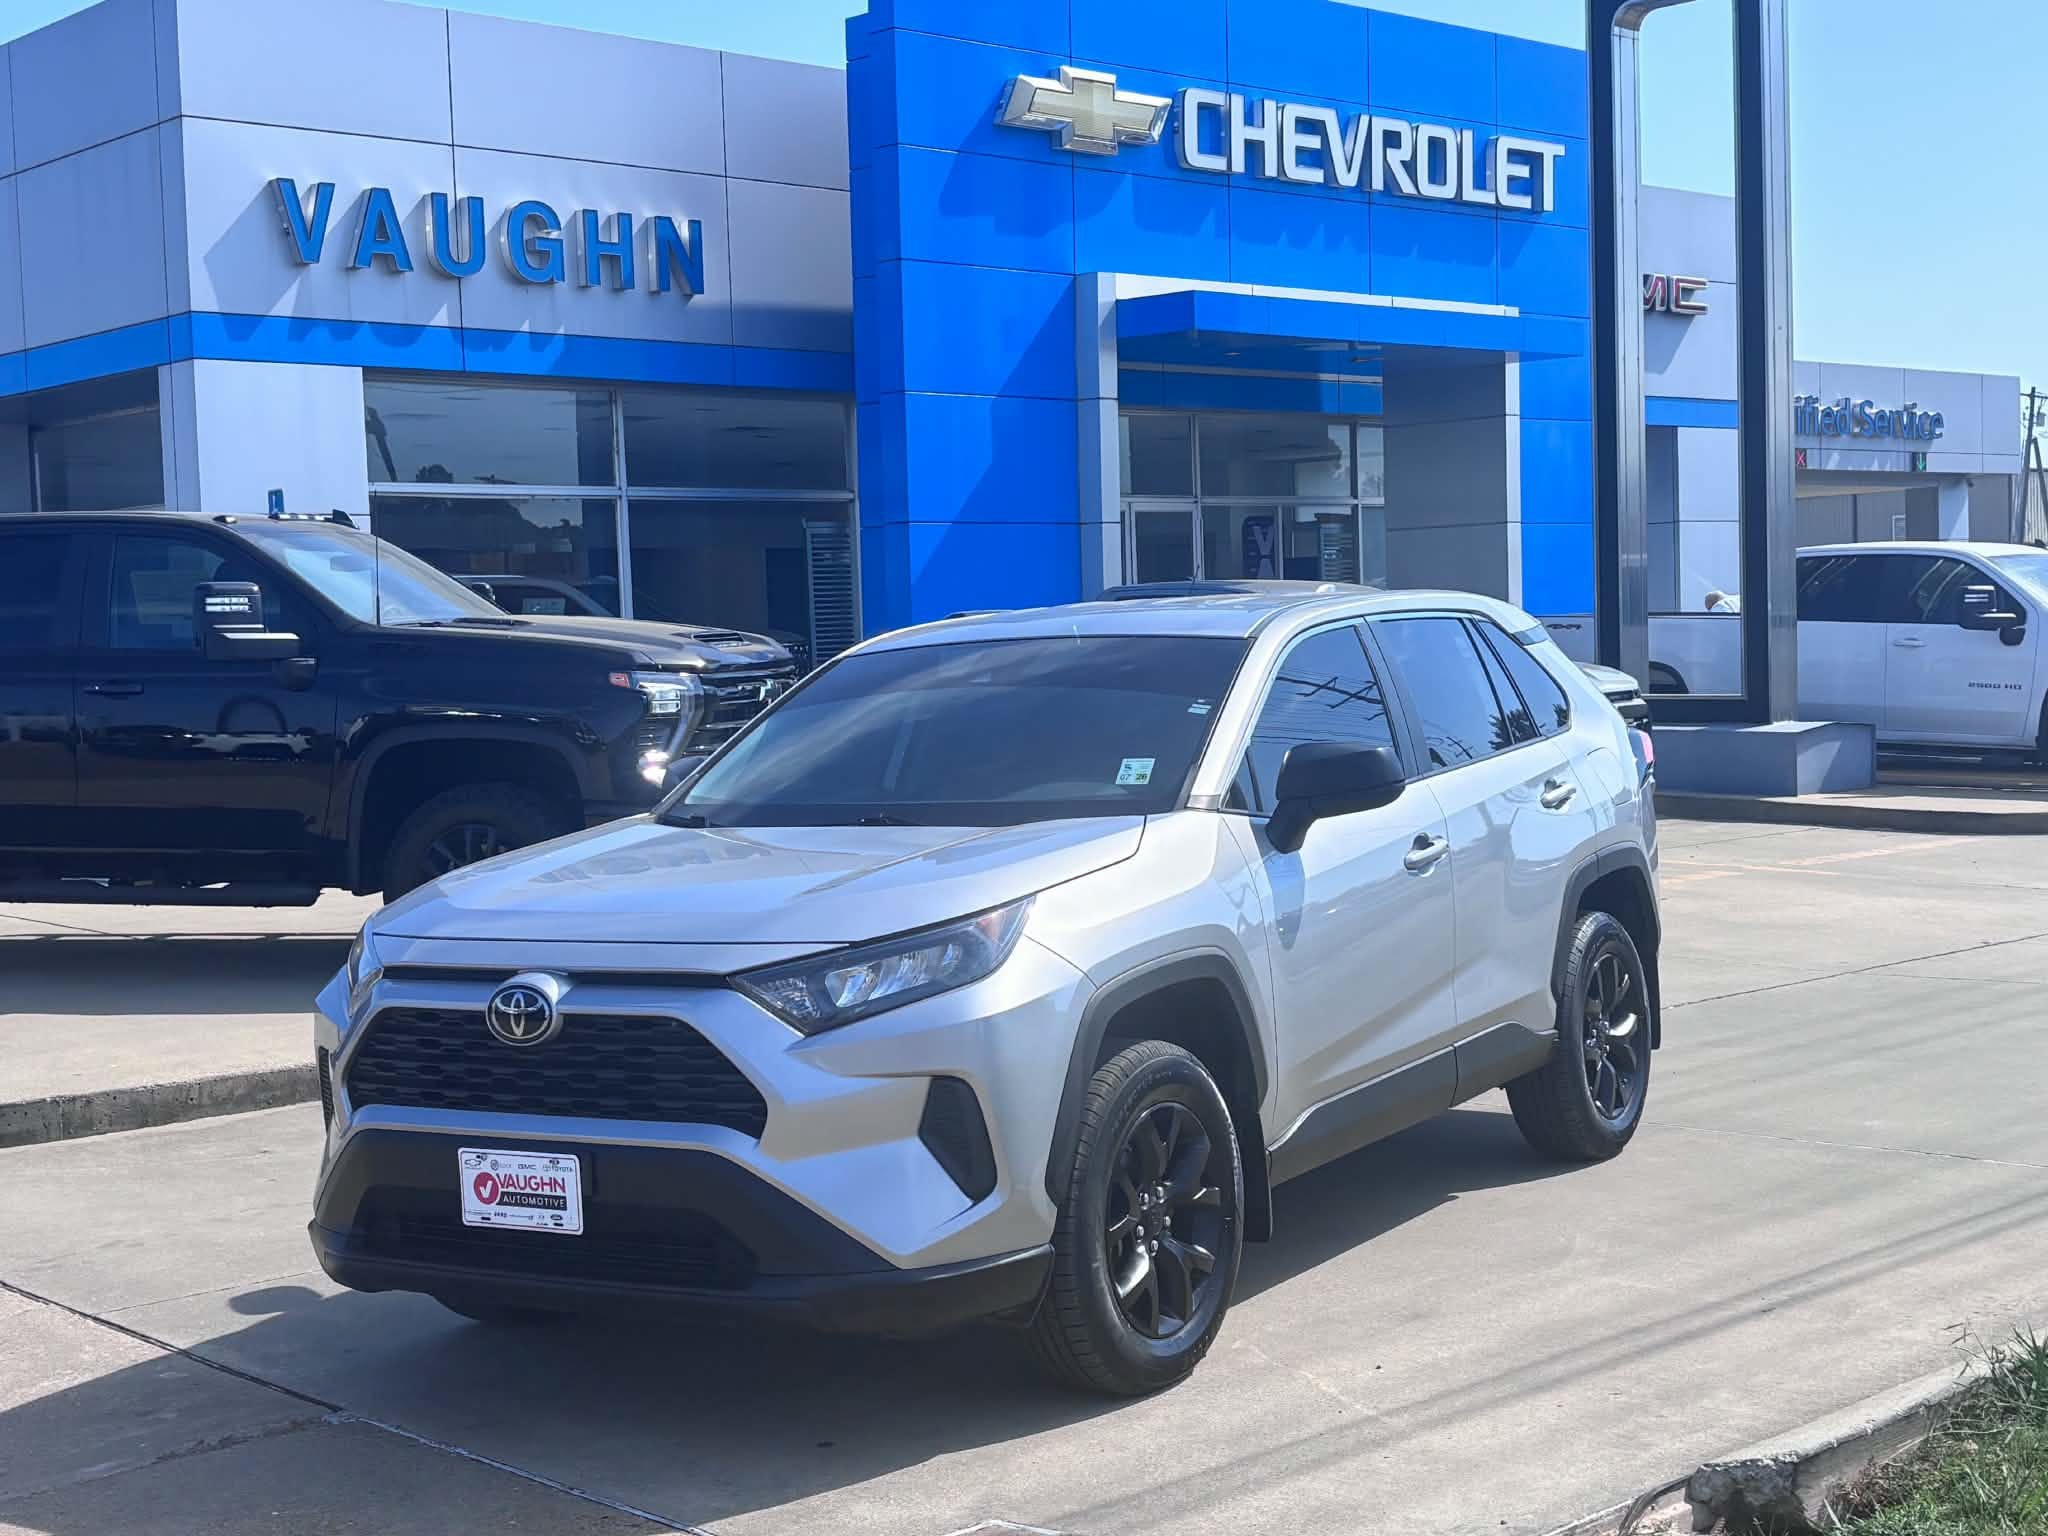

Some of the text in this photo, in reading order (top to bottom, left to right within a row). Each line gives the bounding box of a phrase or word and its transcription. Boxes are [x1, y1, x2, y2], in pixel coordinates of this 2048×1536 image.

[1176, 87, 1566, 213] CHEVROLET
[270, 177, 705, 295] VAUGHN
[1857, 400, 1944, 441] Service
[496, 1172, 566, 1193] VAUGHN
[503, 1195, 565, 1207] AUTOMOTIVE
